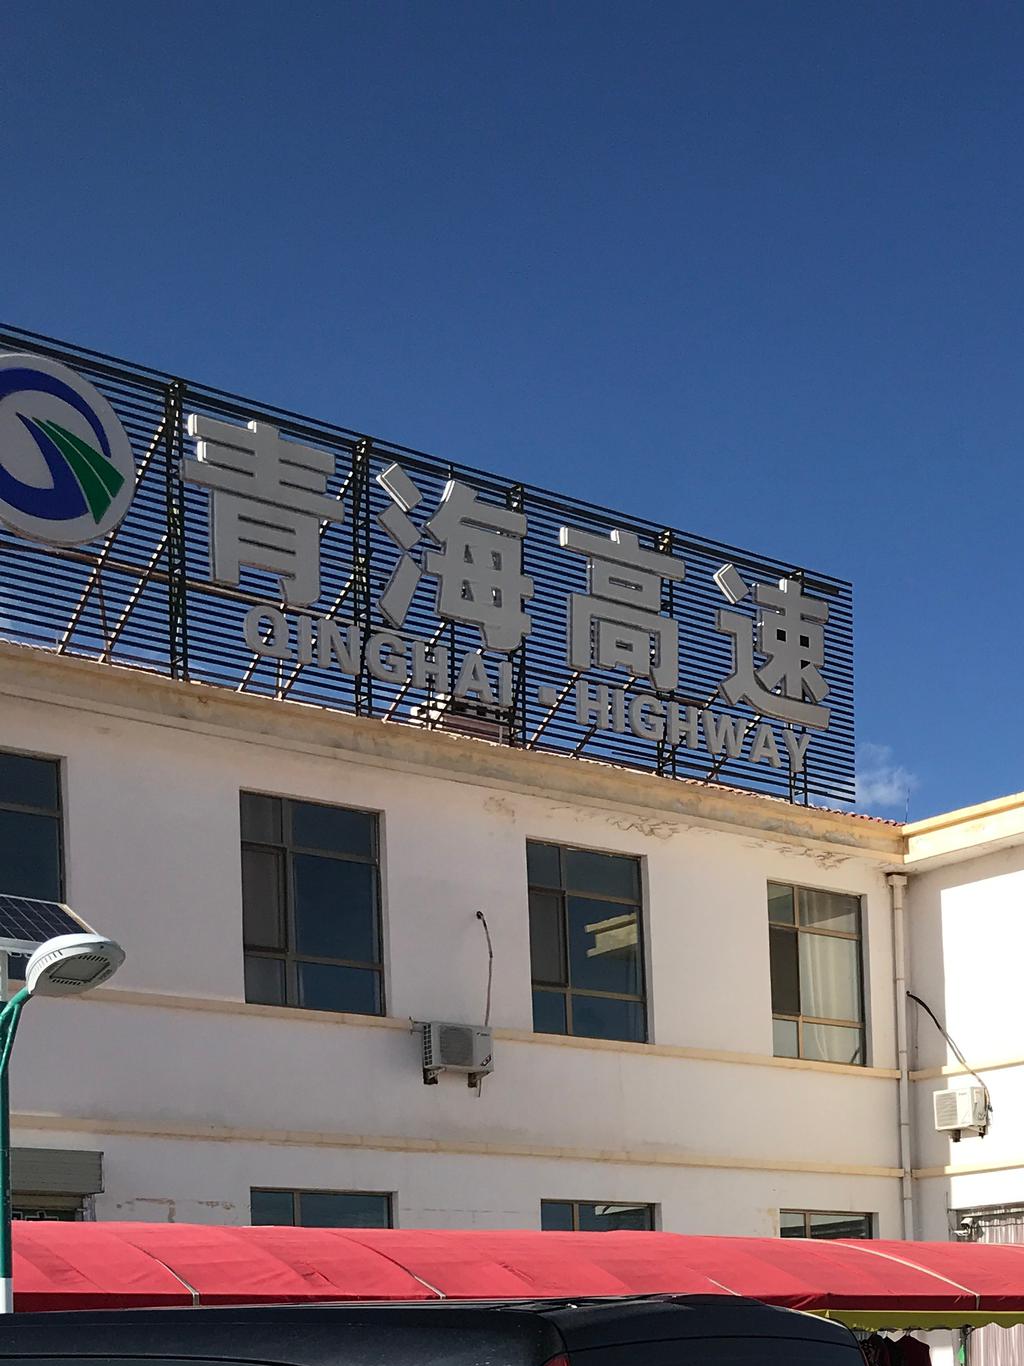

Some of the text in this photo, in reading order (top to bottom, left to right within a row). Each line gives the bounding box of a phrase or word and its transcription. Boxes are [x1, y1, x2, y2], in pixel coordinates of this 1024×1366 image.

[182, 411, 831, 731] 青海高速
[242, 603, 811, 774] QINGHAI HIGHWAY
